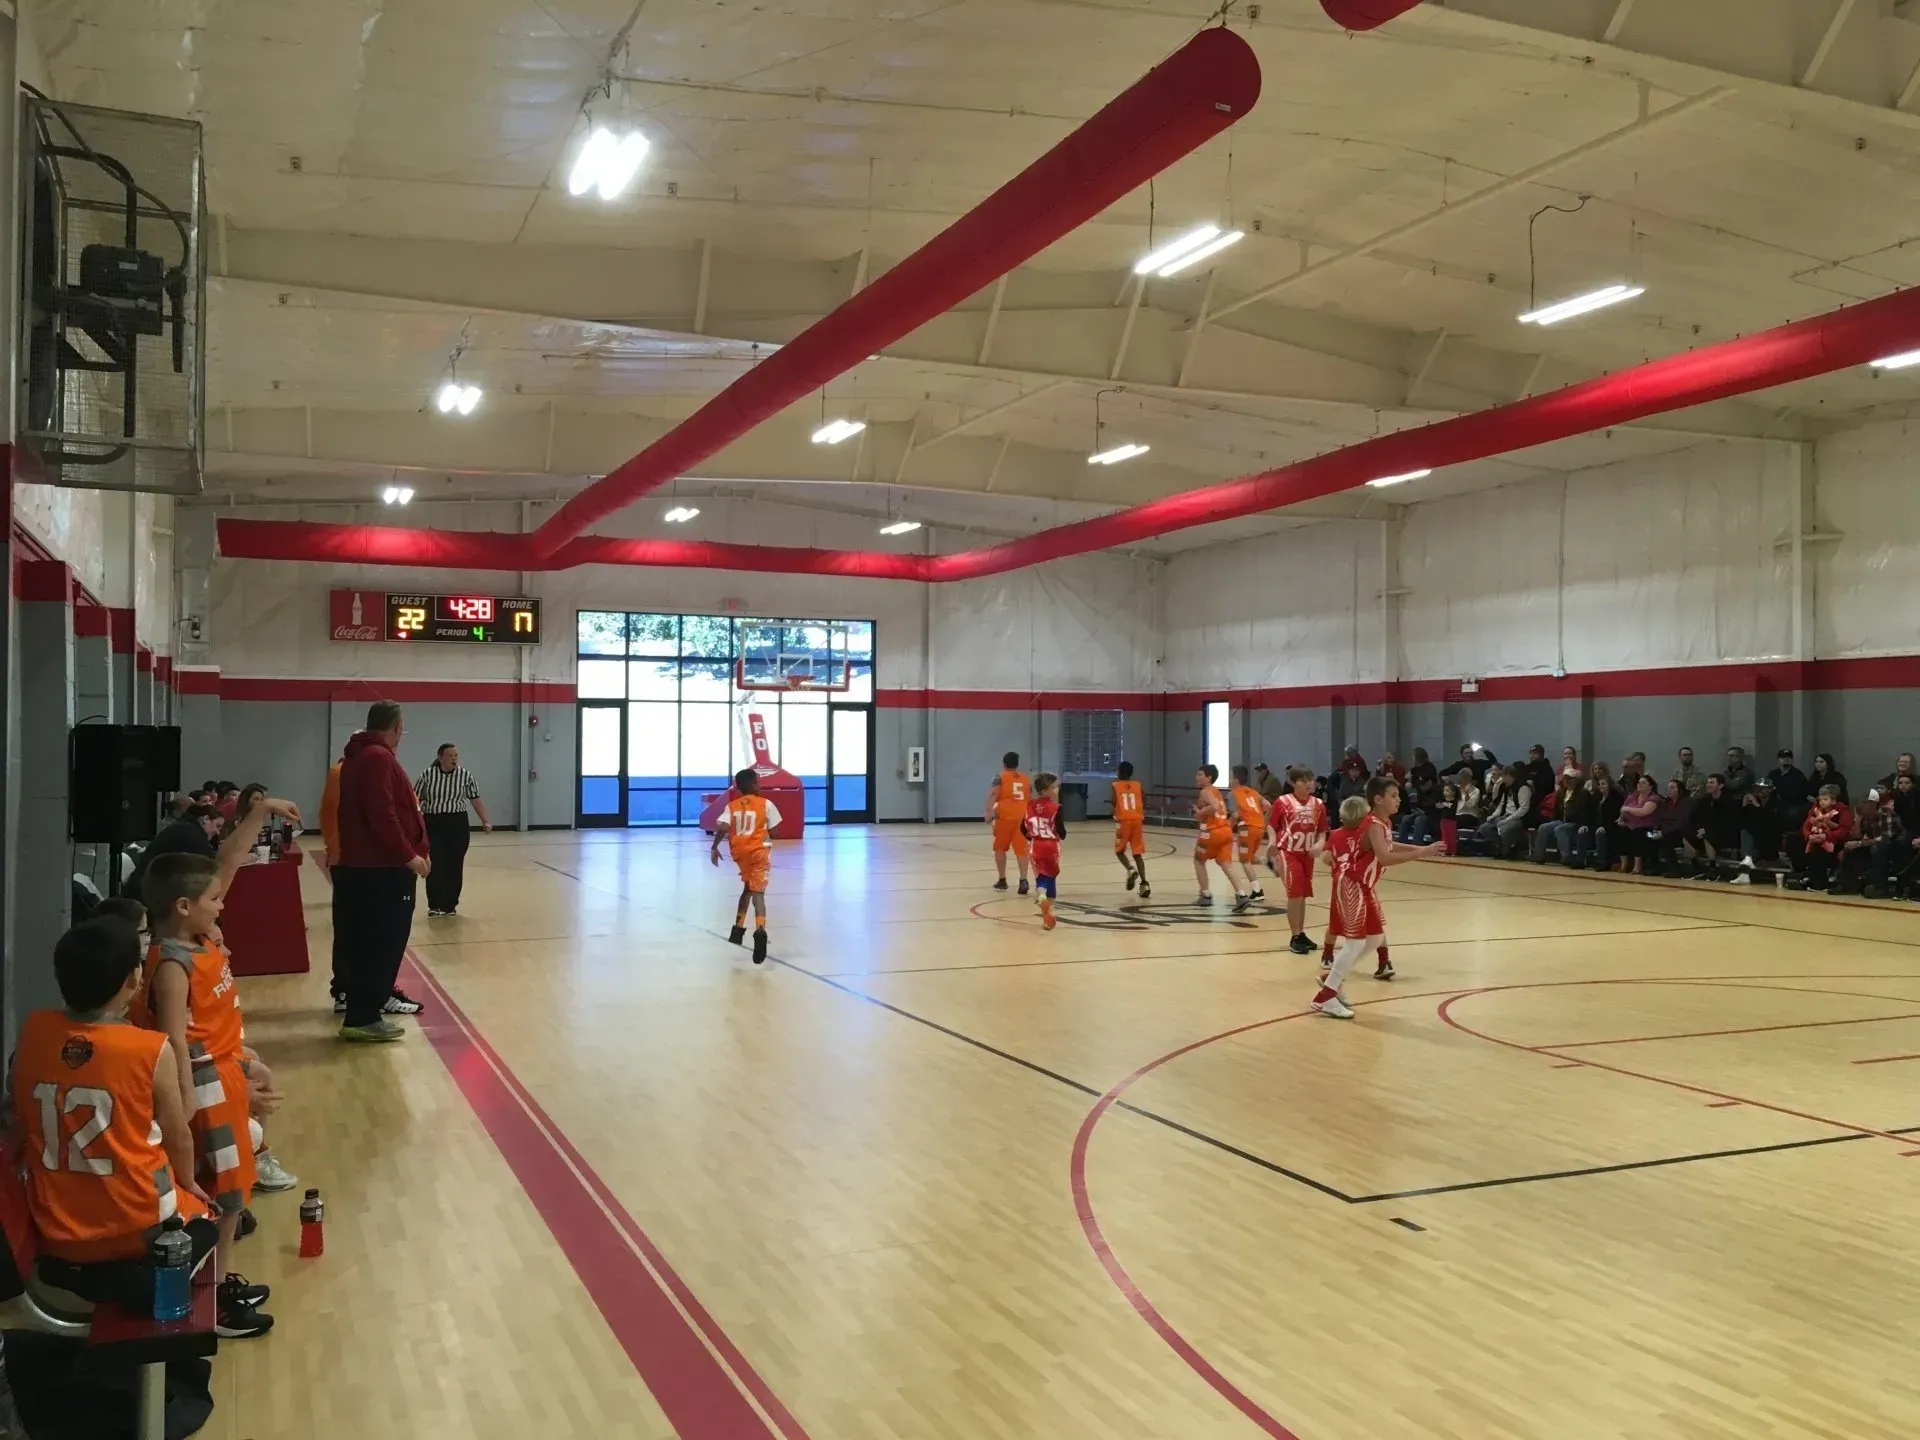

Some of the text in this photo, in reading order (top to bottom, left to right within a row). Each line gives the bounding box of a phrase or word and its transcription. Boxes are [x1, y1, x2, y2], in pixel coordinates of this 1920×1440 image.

[391, 596, 428, 605] GUEST
[450, 599, 491, 619] 4:28
[502, 600, 533, 610] HOME
[397, 608, 425, 630] 22
[514, 612, 533, 633] 17
[334, 625, 378, 640] Coca-Cola
[436, 628, 468, 637] PERIOD
[472, 626, 484, 641] 4
[1012, 782, 1024, 800] 5
[1120, 793, 1136, 811] 11
[1245, 796, 1260, 814] 4
[733, 810, 757, 836] 10
[33, 1082, 114, 1177] 12
